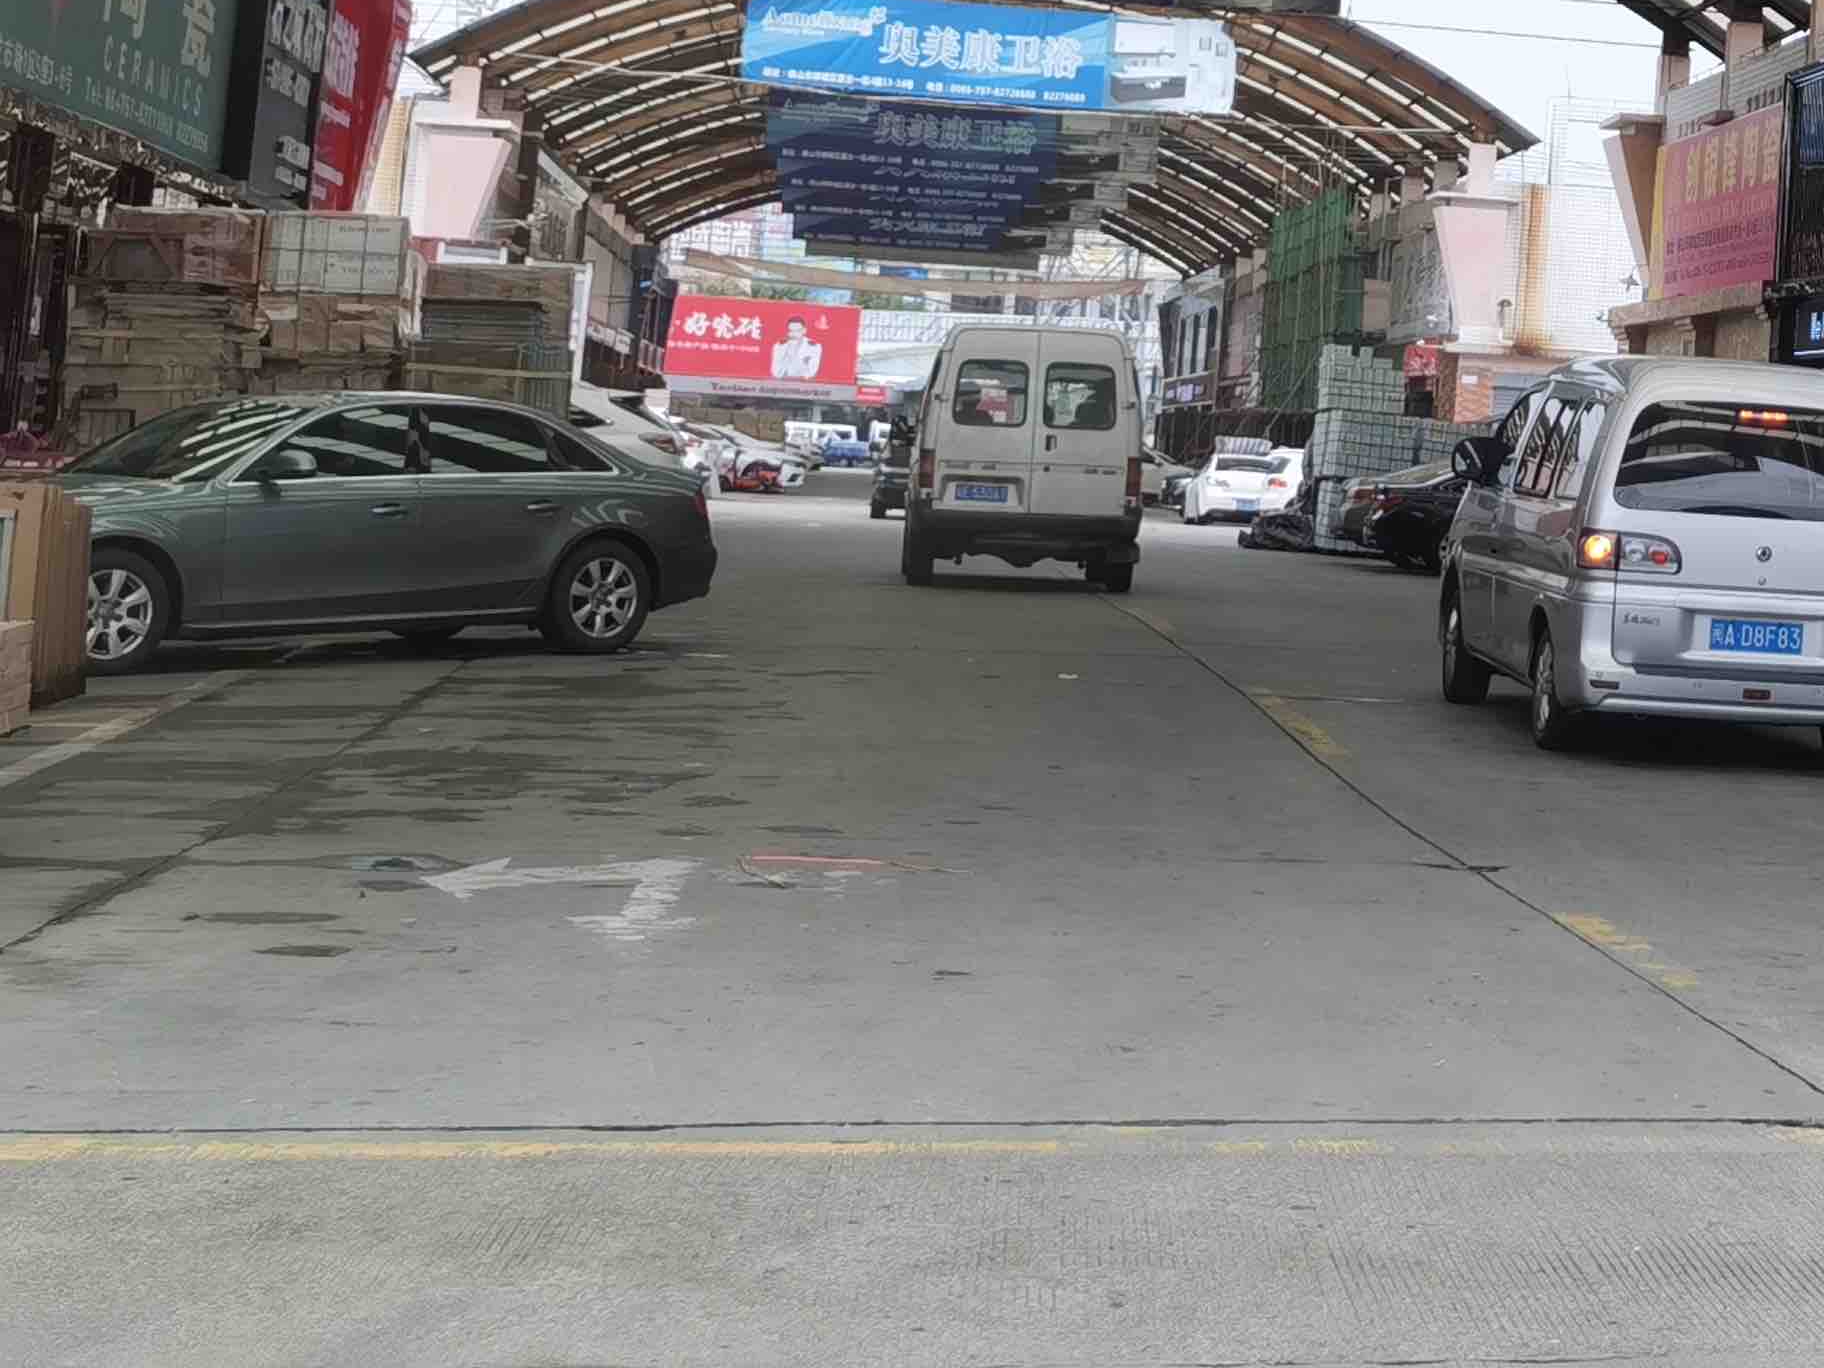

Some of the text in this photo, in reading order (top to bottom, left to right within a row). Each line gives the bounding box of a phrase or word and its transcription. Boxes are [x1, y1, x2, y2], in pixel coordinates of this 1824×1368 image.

[879, 20, 1084, 80] 奥美康卫浴
